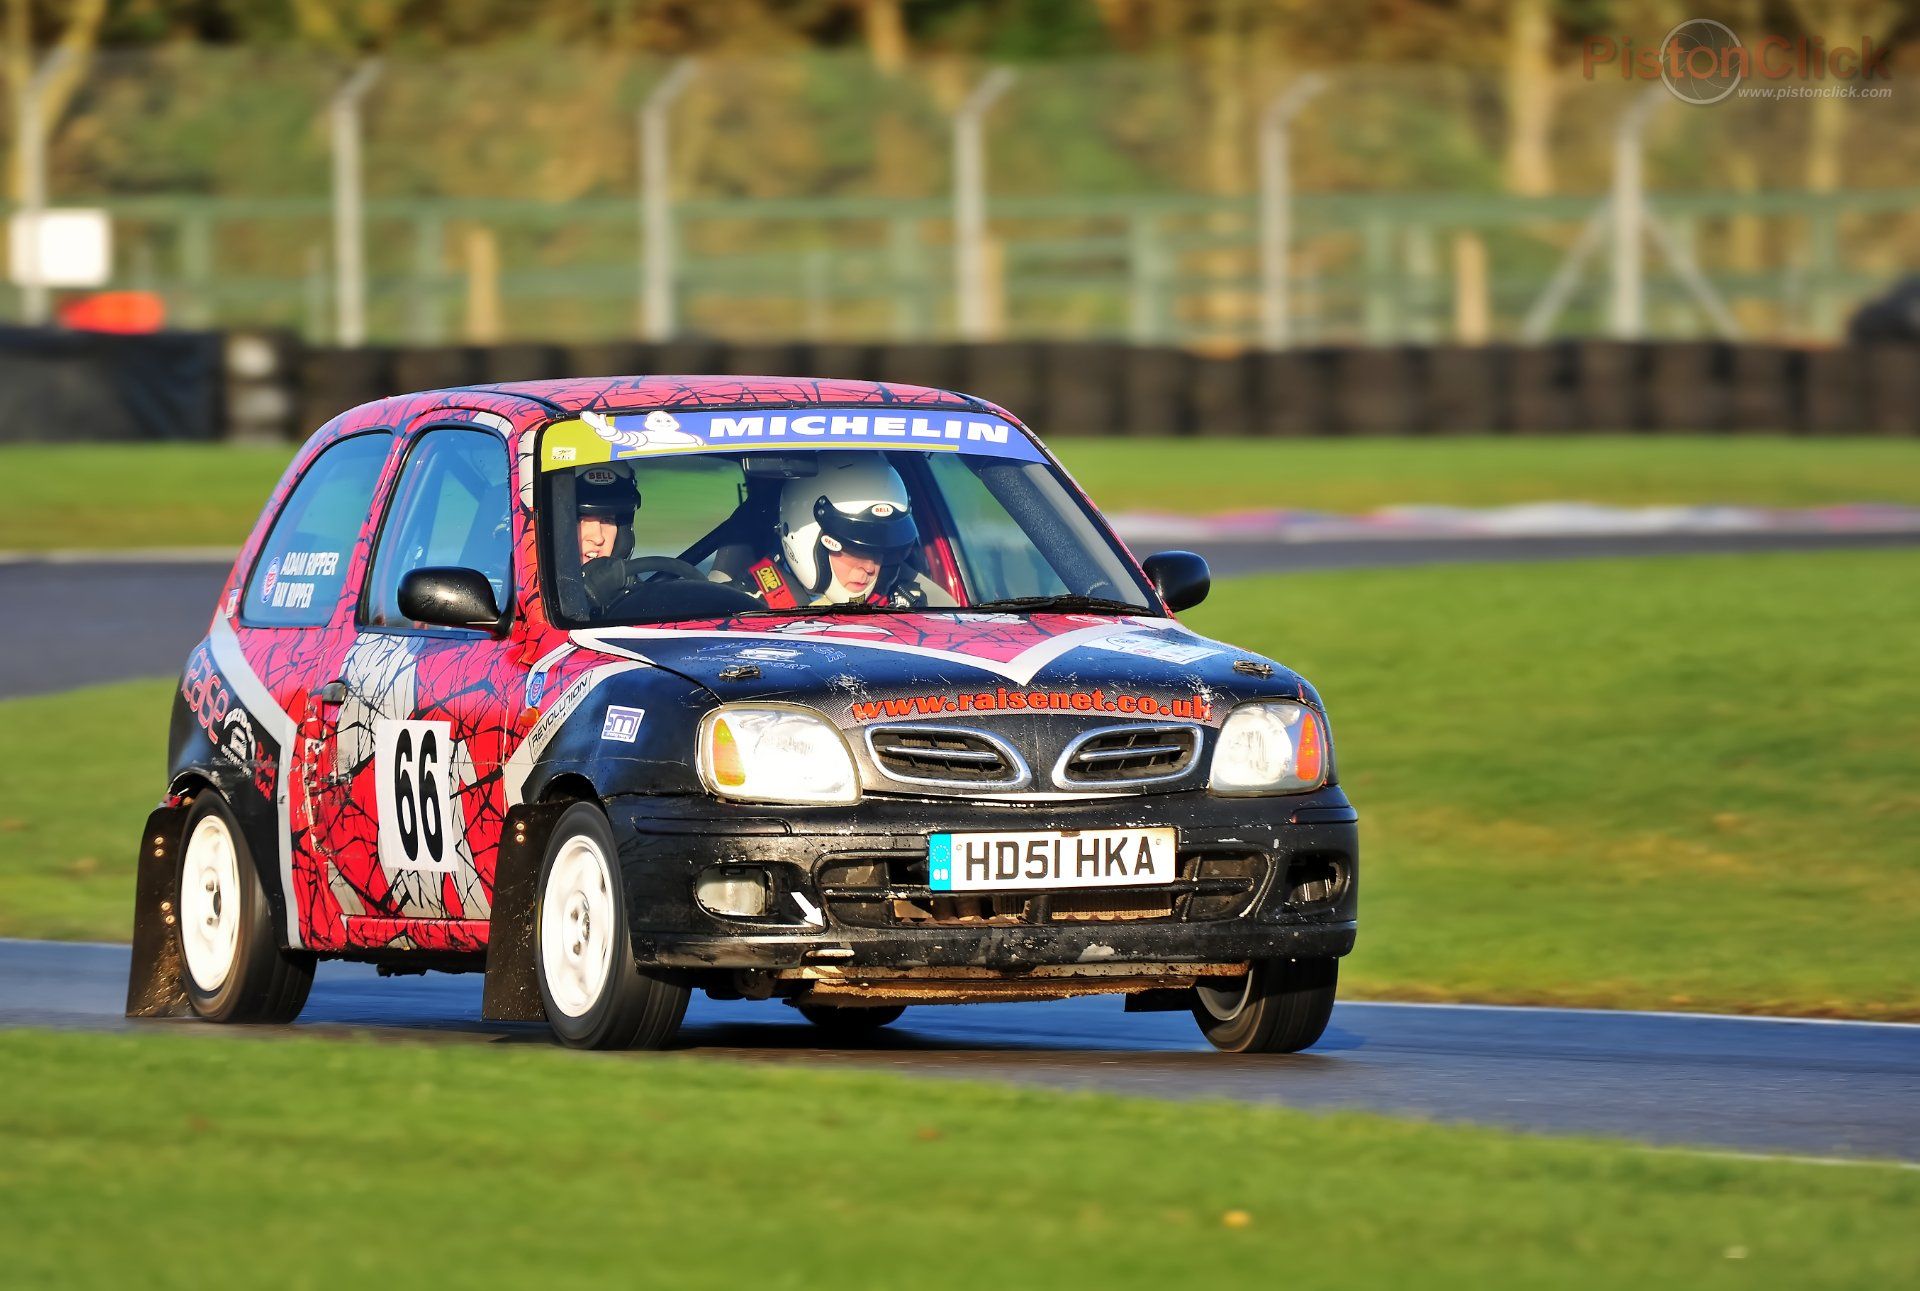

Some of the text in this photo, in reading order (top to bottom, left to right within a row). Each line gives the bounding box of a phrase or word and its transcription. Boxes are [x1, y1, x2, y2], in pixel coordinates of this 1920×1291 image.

[709, 416, 1009, 443] MICHELIN
[588, 471, 613, 480] BELL
[824, 537, 839, 549] BELL
[280, 552, 340, 576] ADAM RIPPER
[760, 567, 778, 590] OMP
[285, 582, 315, 609] RIPPER
[531, 676, 589, 748] REVOLUTION
[852, 687, 1214, 721] www.raisenet.co.uk
[394, 728, 444, 863] 66
[966, 836, 1155, 881] HD51 HKA
